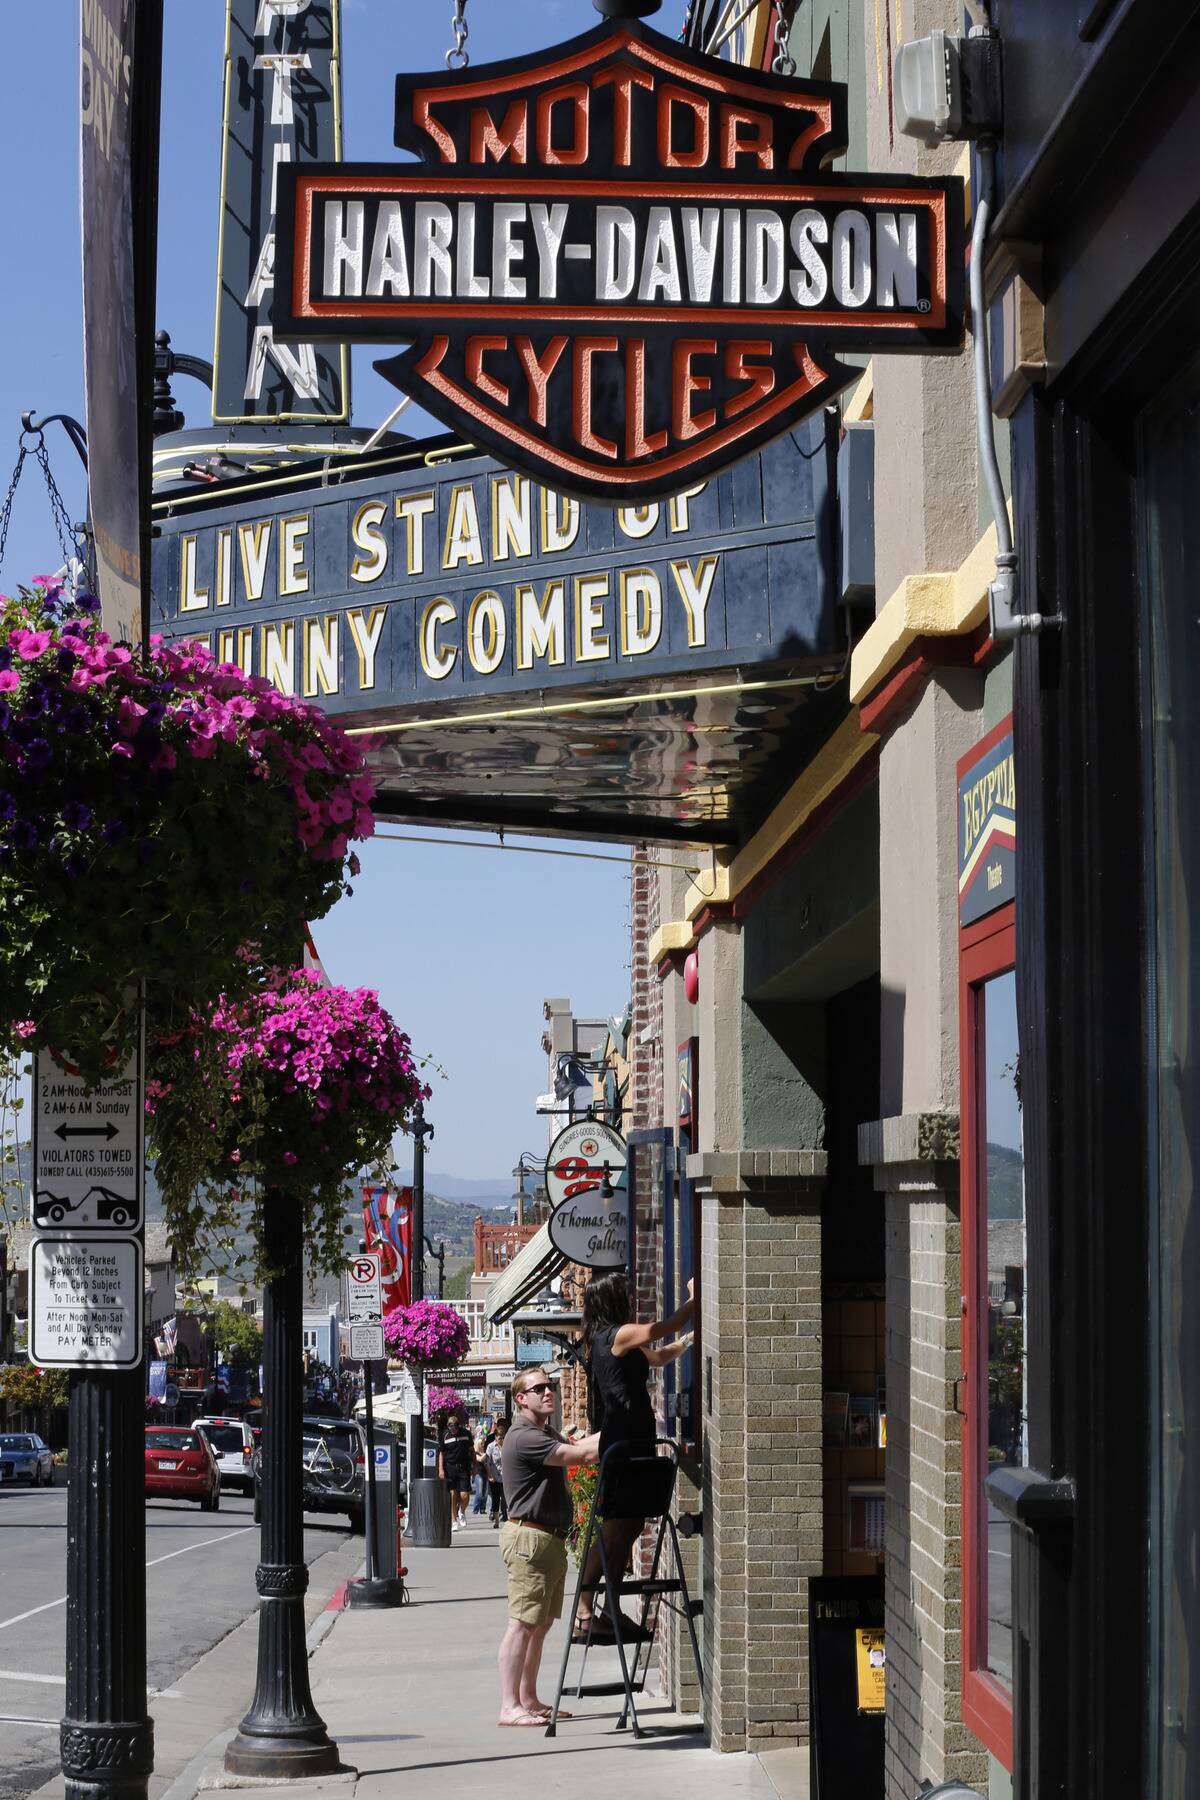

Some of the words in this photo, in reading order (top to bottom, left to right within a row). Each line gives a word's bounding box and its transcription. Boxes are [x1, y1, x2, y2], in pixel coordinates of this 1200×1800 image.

[82, 48, 115, 161] DAY
[470, 61, 774, 170] MOTOR
[323, 200, 918, 308] HARLEY-DAVIDSON
[466, 334, 776, 461] CYCLES
[181, 512, 309, 612] LIVE
[351, 473, 580, 583] STAND
[187, 604, 389, 698] NNY
[419, 554, 720, 680] COMEDY
[42, 1084, 49, 1098] 2
[50, 1084, 90, 1098] AM-Noo
[44, 1102, 50, 1115] 2
[78, 1101, 92, 1114] AM
[95, 1101, 130, 1117] Sunday
[42, 1149, 95, 1163] VIOLATORS
[98, 1149, 132, 1162] TOWED
[40, 1166, 64, 1177] TOWED?
[66, 1166, 82, 1177] CALL
[557, 1206, 603, 1228] Thomas
[55, 1255, 86, 1265] Vehicles
[89, 1255, 116, 1265] Parked
[51, 1267, 80, 1277] Beyond
[82, 1267, 90, 1276] 12
[93, 1267, 118, 1276] Inches
[49, 1280, 68, 1289] From
[70, 1280, 88, 1290] Curb
[91, 1280, 121, 1292] Subject
[54, 1294, 62, 1304] To
[65, 1294, 88, 1304] Ticket
[92, 1294, 98, 1304] &
[102, 1294, 117, 1304] Tow
[46, 1312, 66, 1322] After
[69, 1312, 89, 1322] Noon
[91, 1312, 123, 1323] Mon-Sat
[47, 1325, 61, 1333] and
[64, 1324, 73, 1333] All
[76, 1324, 91, 1334] Day
[94, 1324, 122, 1336] Sunday
[57, 1336, 77, 1346] PAY
[81, 1336, 112, 1347] METER
